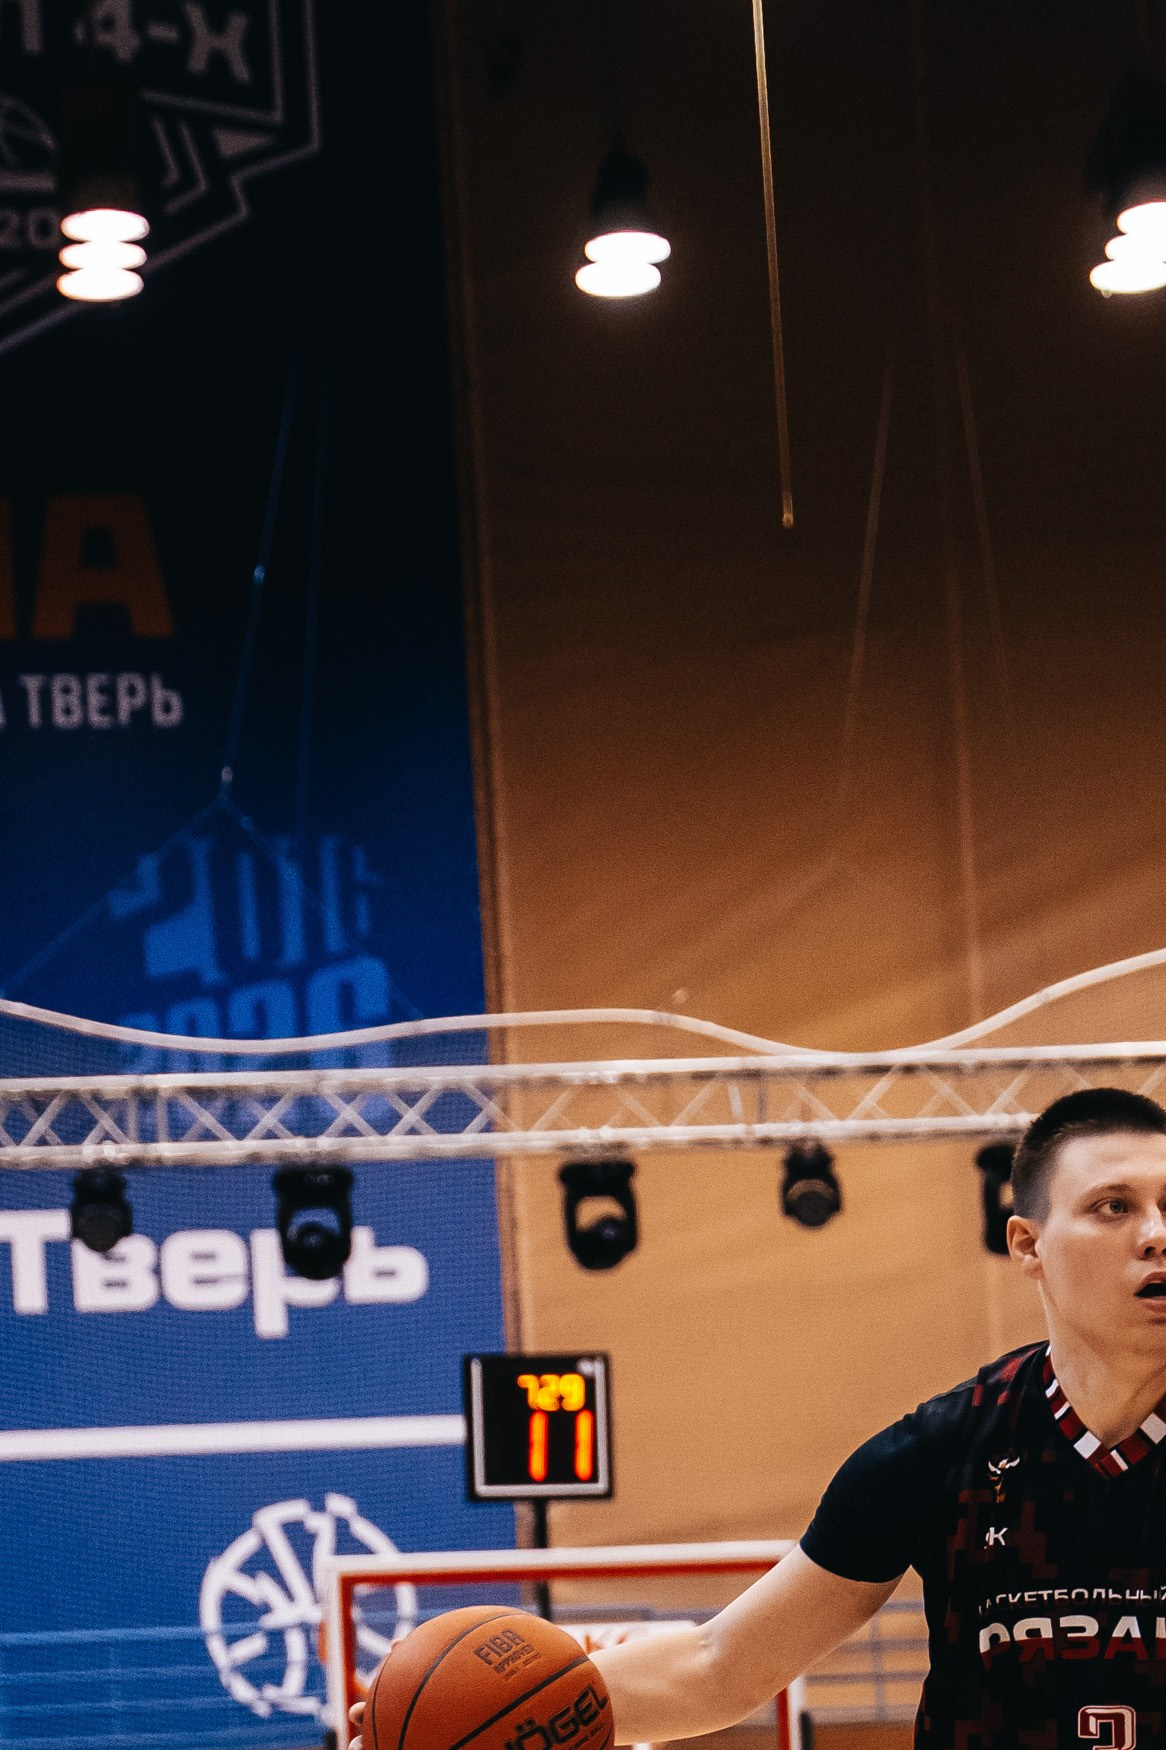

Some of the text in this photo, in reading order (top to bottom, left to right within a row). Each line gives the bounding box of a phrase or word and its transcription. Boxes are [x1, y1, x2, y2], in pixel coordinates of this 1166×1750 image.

[0, 493, 176, 640] А
[18, 671, 184, 730] ТВЕРЬ
[0, 1208, 430, 1340] Тверь
[529, 1409, 594, 1483] 11
[474, 1628, 526, 1666] FIBA
